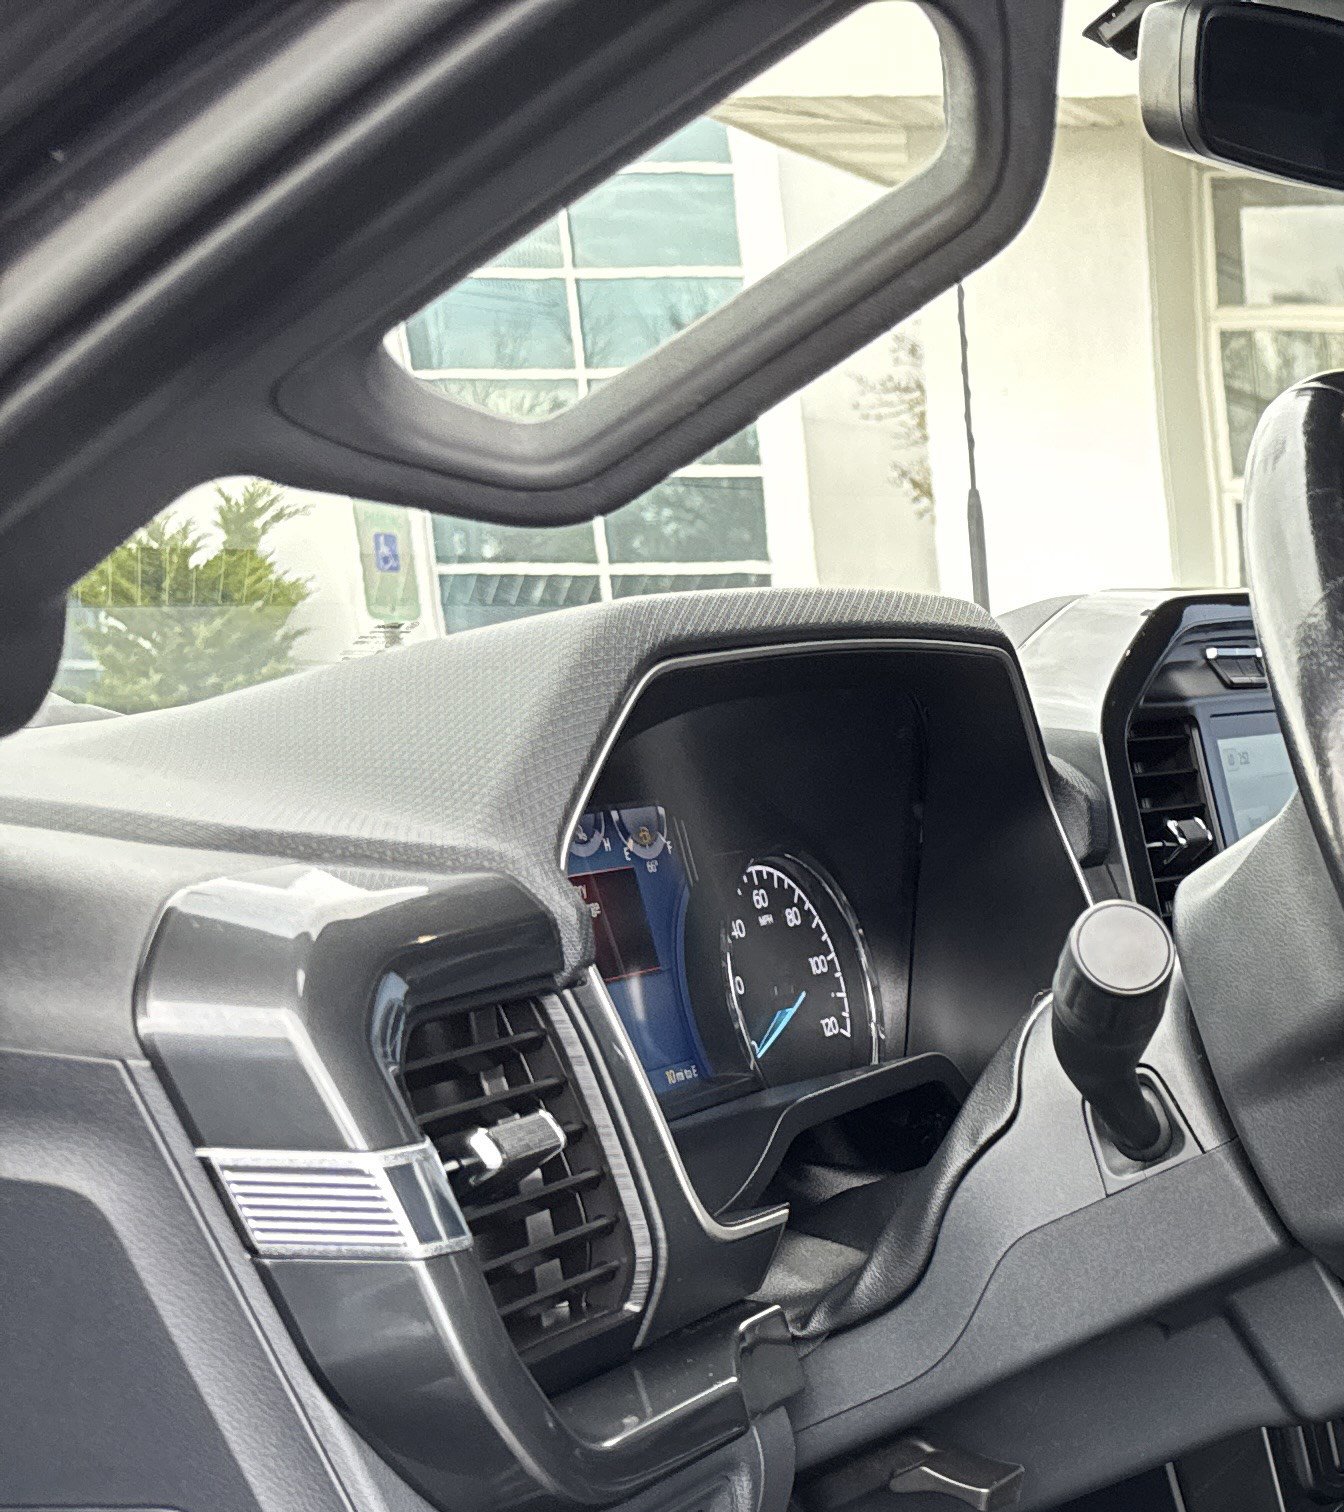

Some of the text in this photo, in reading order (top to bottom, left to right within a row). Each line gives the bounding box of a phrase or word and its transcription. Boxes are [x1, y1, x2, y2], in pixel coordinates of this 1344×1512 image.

[752, 889, 769, 909] 60
[785, 907, 801, 927] 80
[808, 954, 828, 975] 100
[820, 1016, 839, 1037] 120
